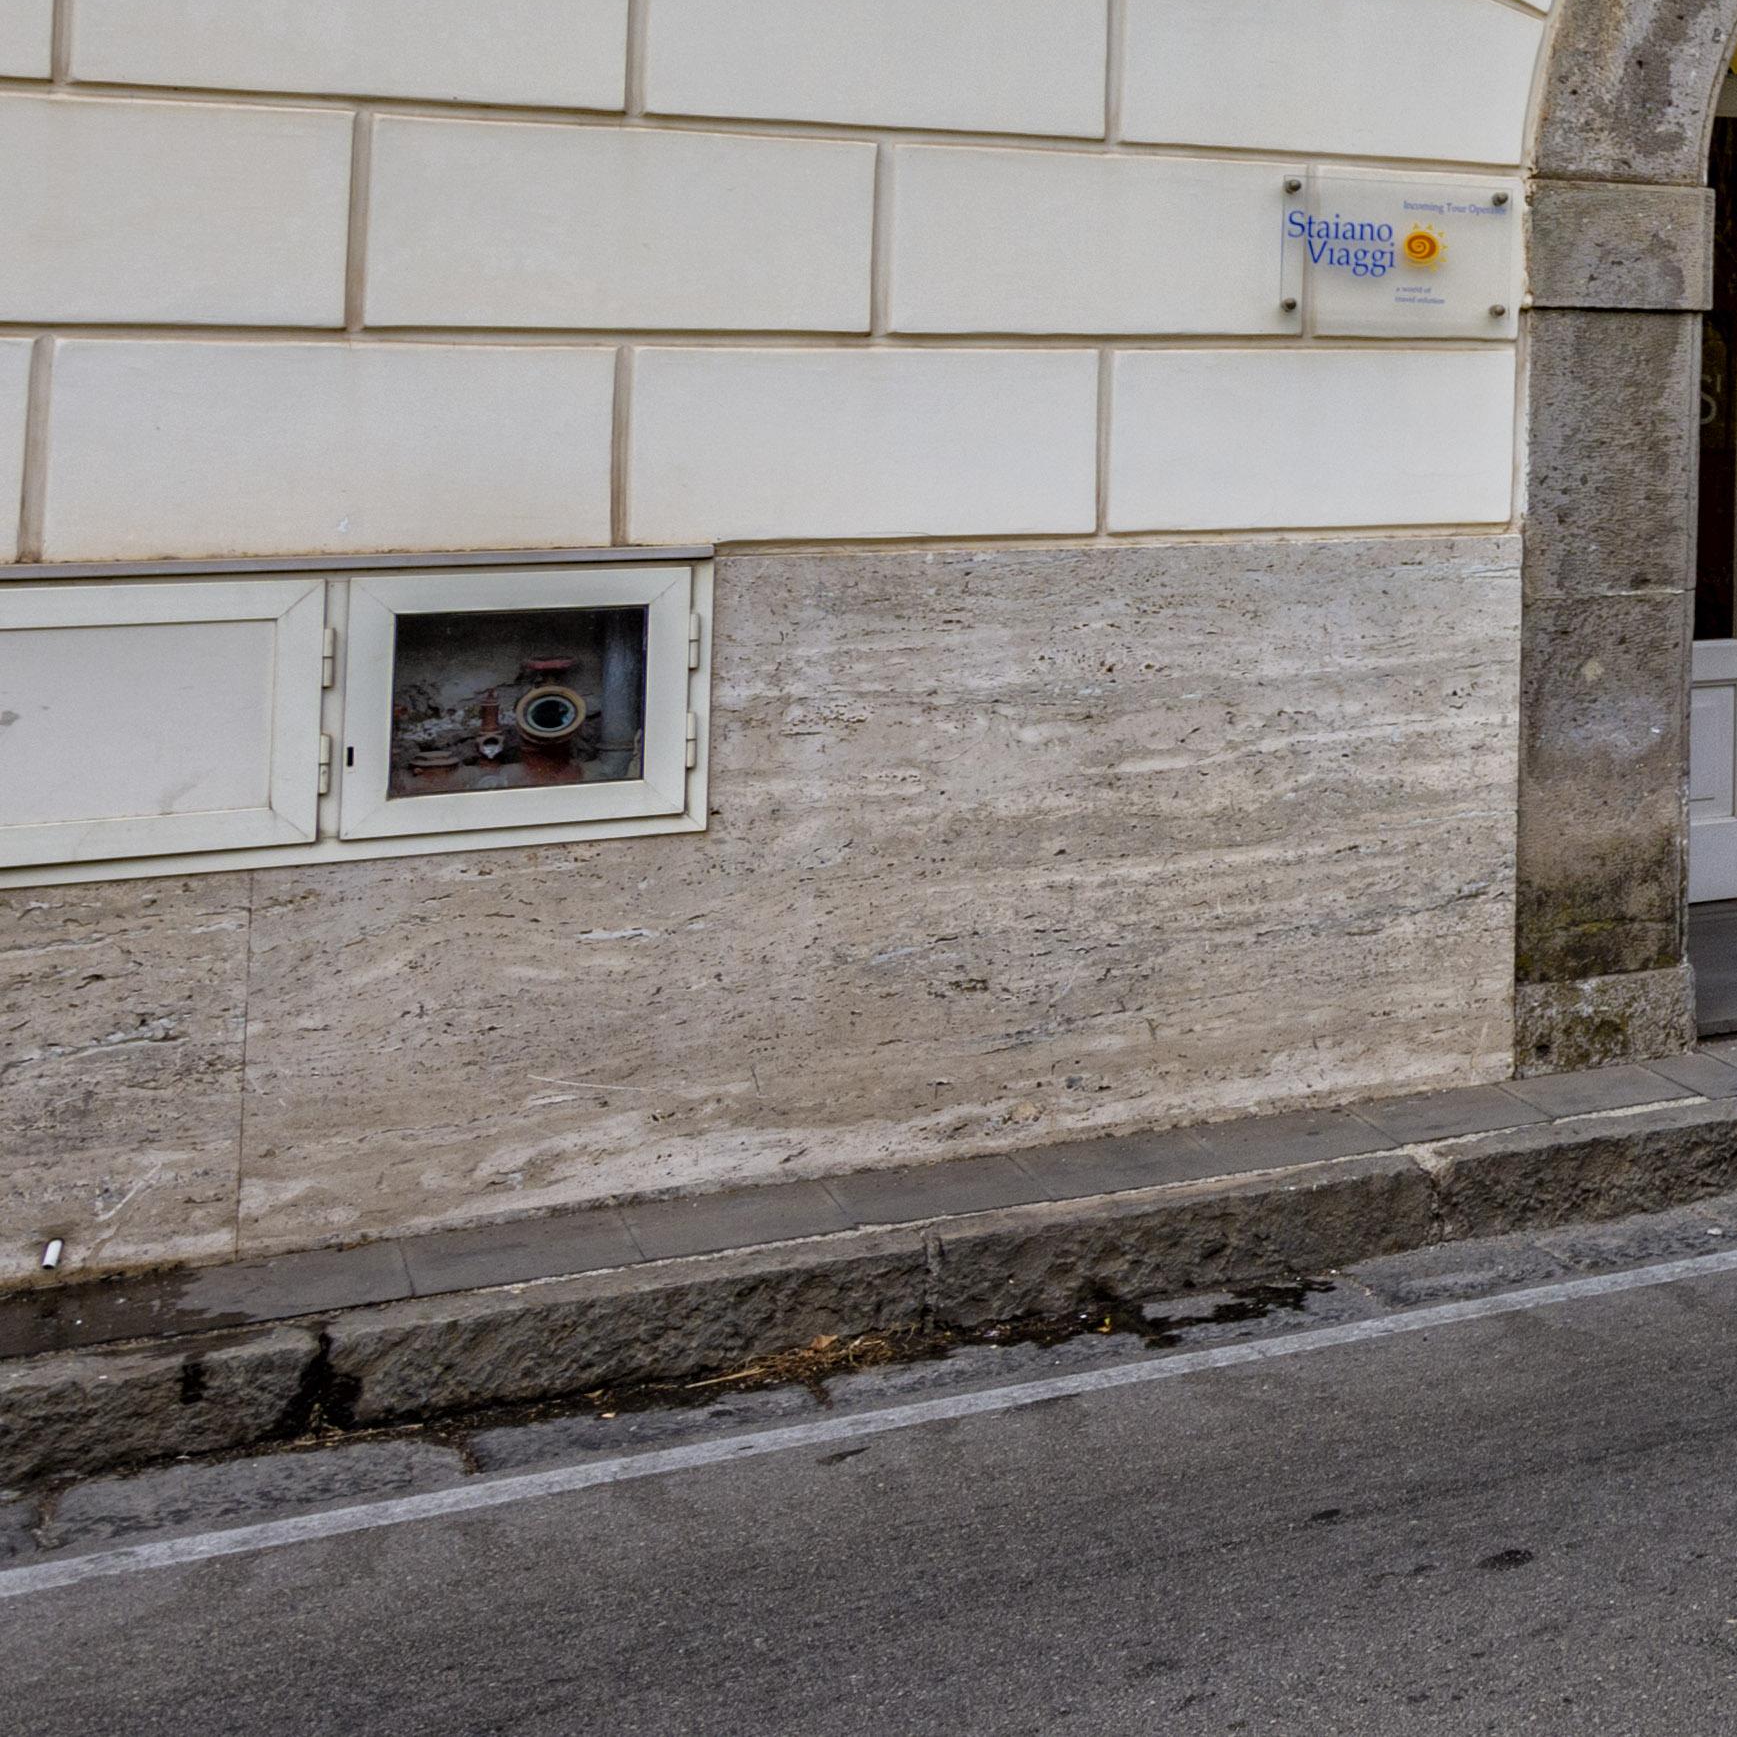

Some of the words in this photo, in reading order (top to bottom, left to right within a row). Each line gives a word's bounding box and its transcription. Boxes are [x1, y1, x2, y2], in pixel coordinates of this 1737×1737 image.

[1403, 200, 1444, 215] Incoming
[1446, 202, 1467, 214] Tour
[1286, 209, 1394, 243] Staiano
[1306, 238, 1397, 278] Viaggi
